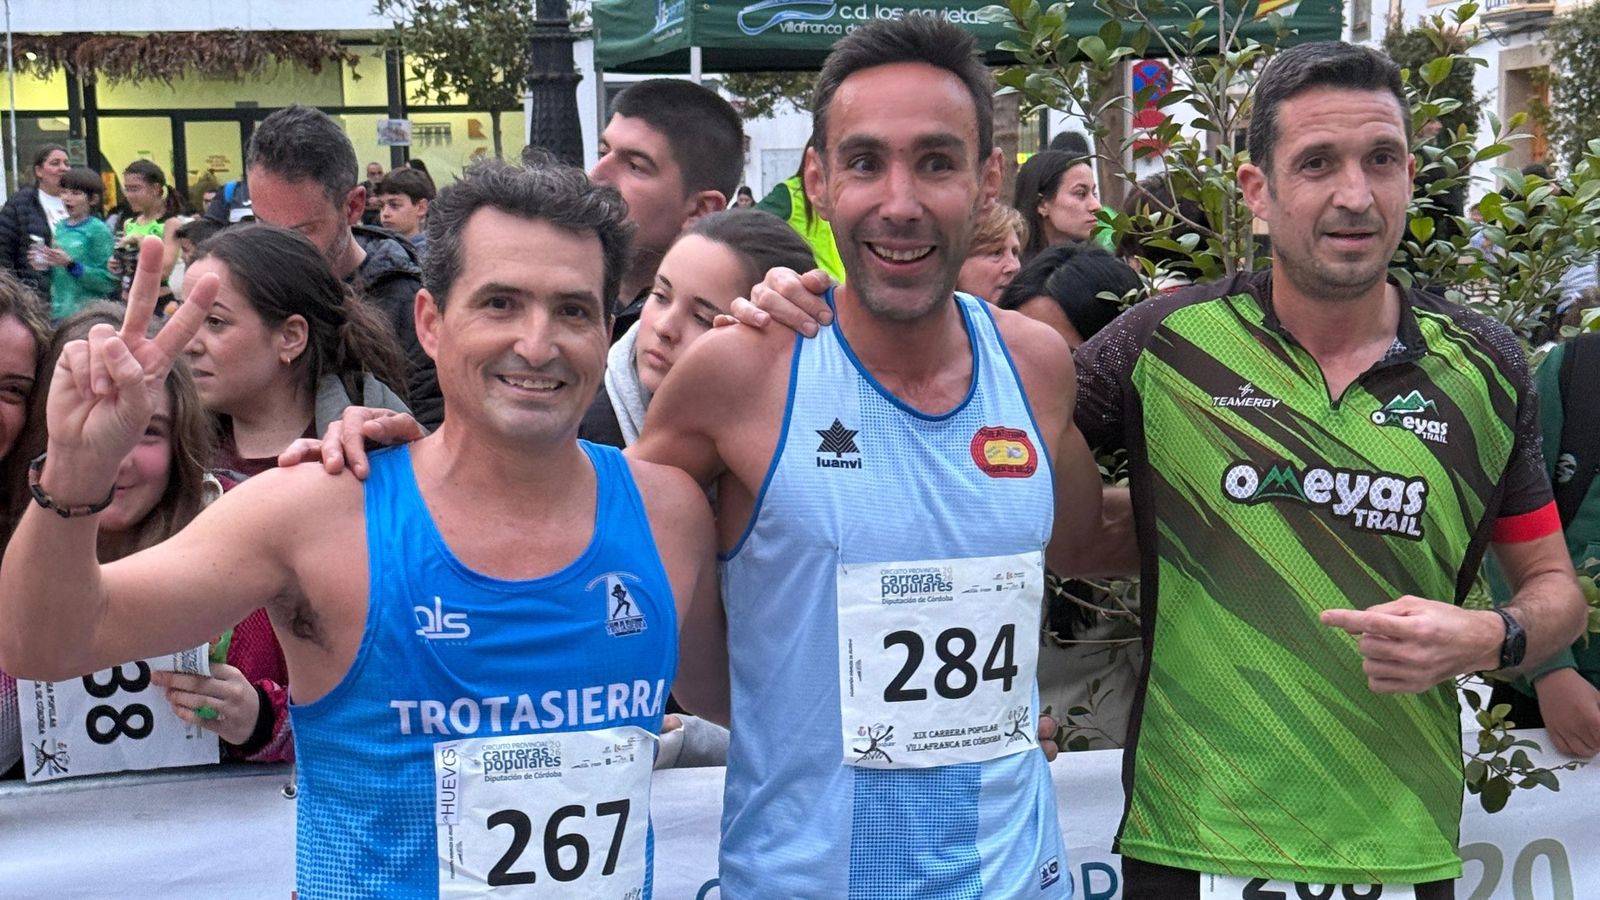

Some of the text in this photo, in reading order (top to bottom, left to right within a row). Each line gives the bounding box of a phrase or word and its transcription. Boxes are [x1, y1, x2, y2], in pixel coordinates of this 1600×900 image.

[875, 4, 904, 21] los
[779, 21, 843, 35] villafranca
[1213, 396, 1280, 408] TEAMERGY
[1421, 431, 1448, 444] TRAIL
[816, 456, 862, 469] luanvi
[1353, 507, 1421, 537] TRAIL
[881, 573, 942, 585] carreras
[881, 579, 953, 598] populares
[883, 623, 1018, 703] 284
[390, 678, 666, 736] TROTASIERRA
[912, 723, 998, 740] XIX CARRERA POPULAR
[905, 740, 960, 752] VILLAFRANCA
[961, 738, 972, 748] DE
[482, 747, 549, 761] carreras
[484, 756, 562, 775] populares
[484, 770, 562, 783] Diputación de Córdoba
[486, 798, 631, 887] 267
